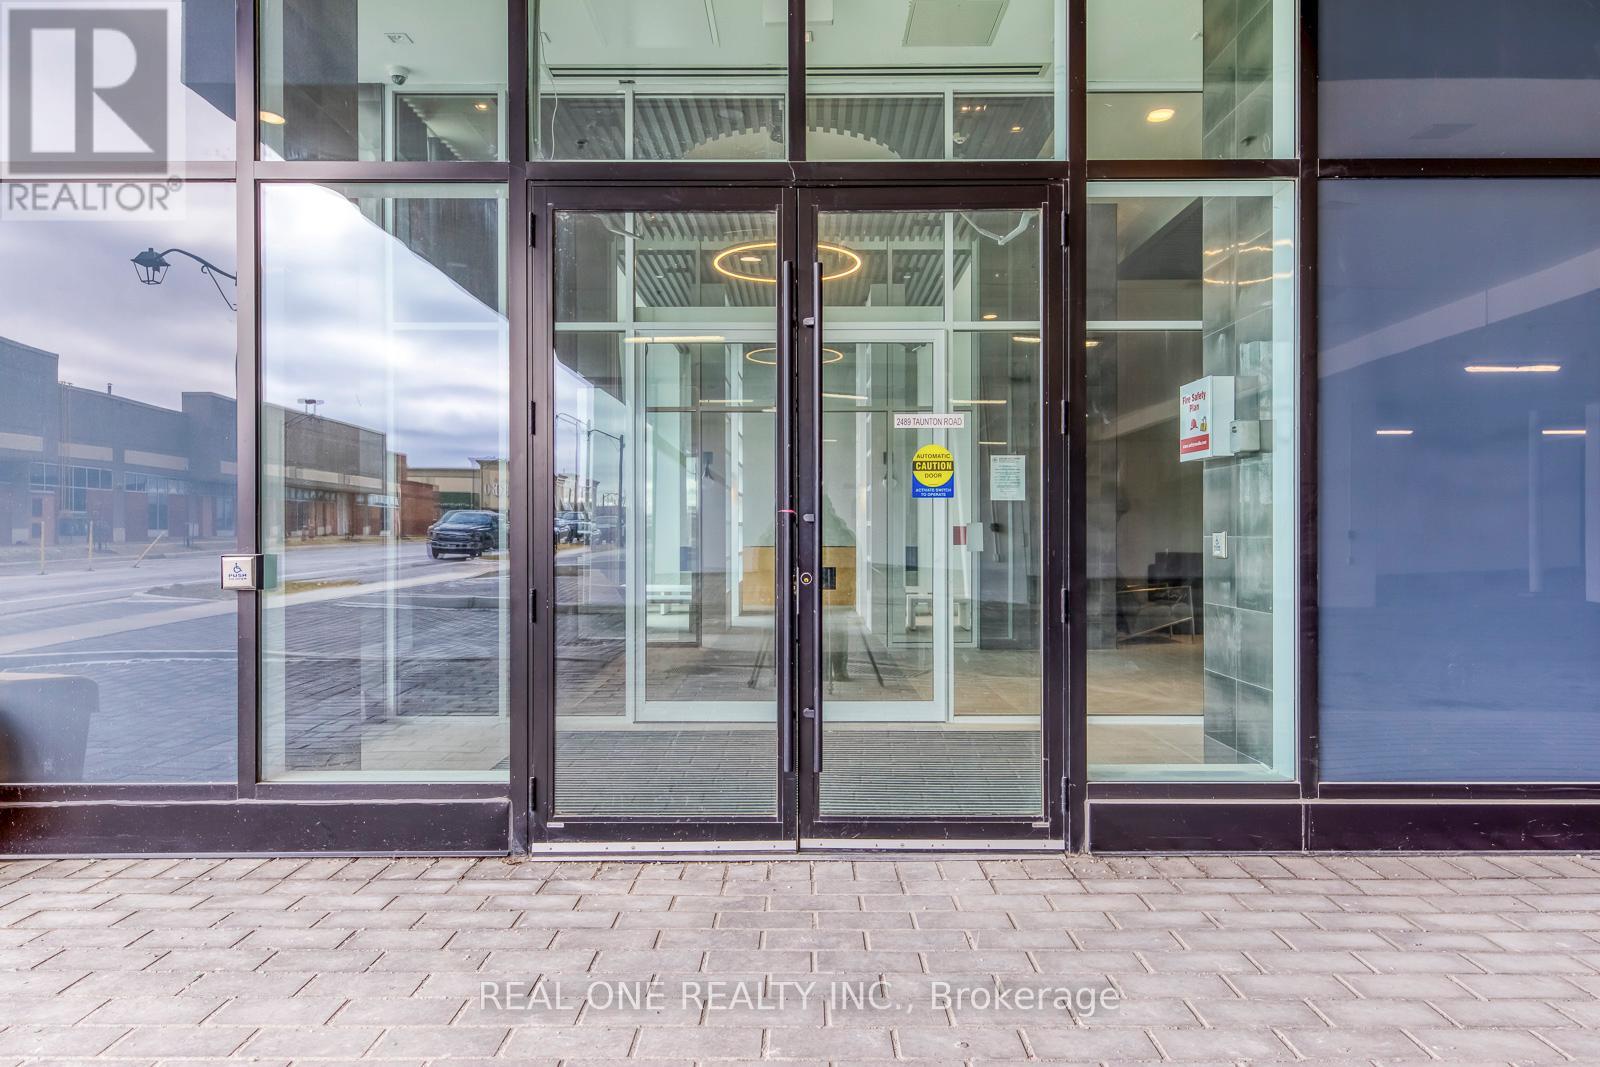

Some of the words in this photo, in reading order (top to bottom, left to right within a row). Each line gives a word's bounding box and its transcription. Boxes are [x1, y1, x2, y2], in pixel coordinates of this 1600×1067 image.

[1182, 396, 1190, 405] Fire
[1192, 390, 1206, 401] Safety
[1190, 404, 1200, 412] Plan
[896, 418, 911, 426] 2489
[912, 418, 942, 426] TAUNTON
[915, 461, 952, 470] CAUTION
